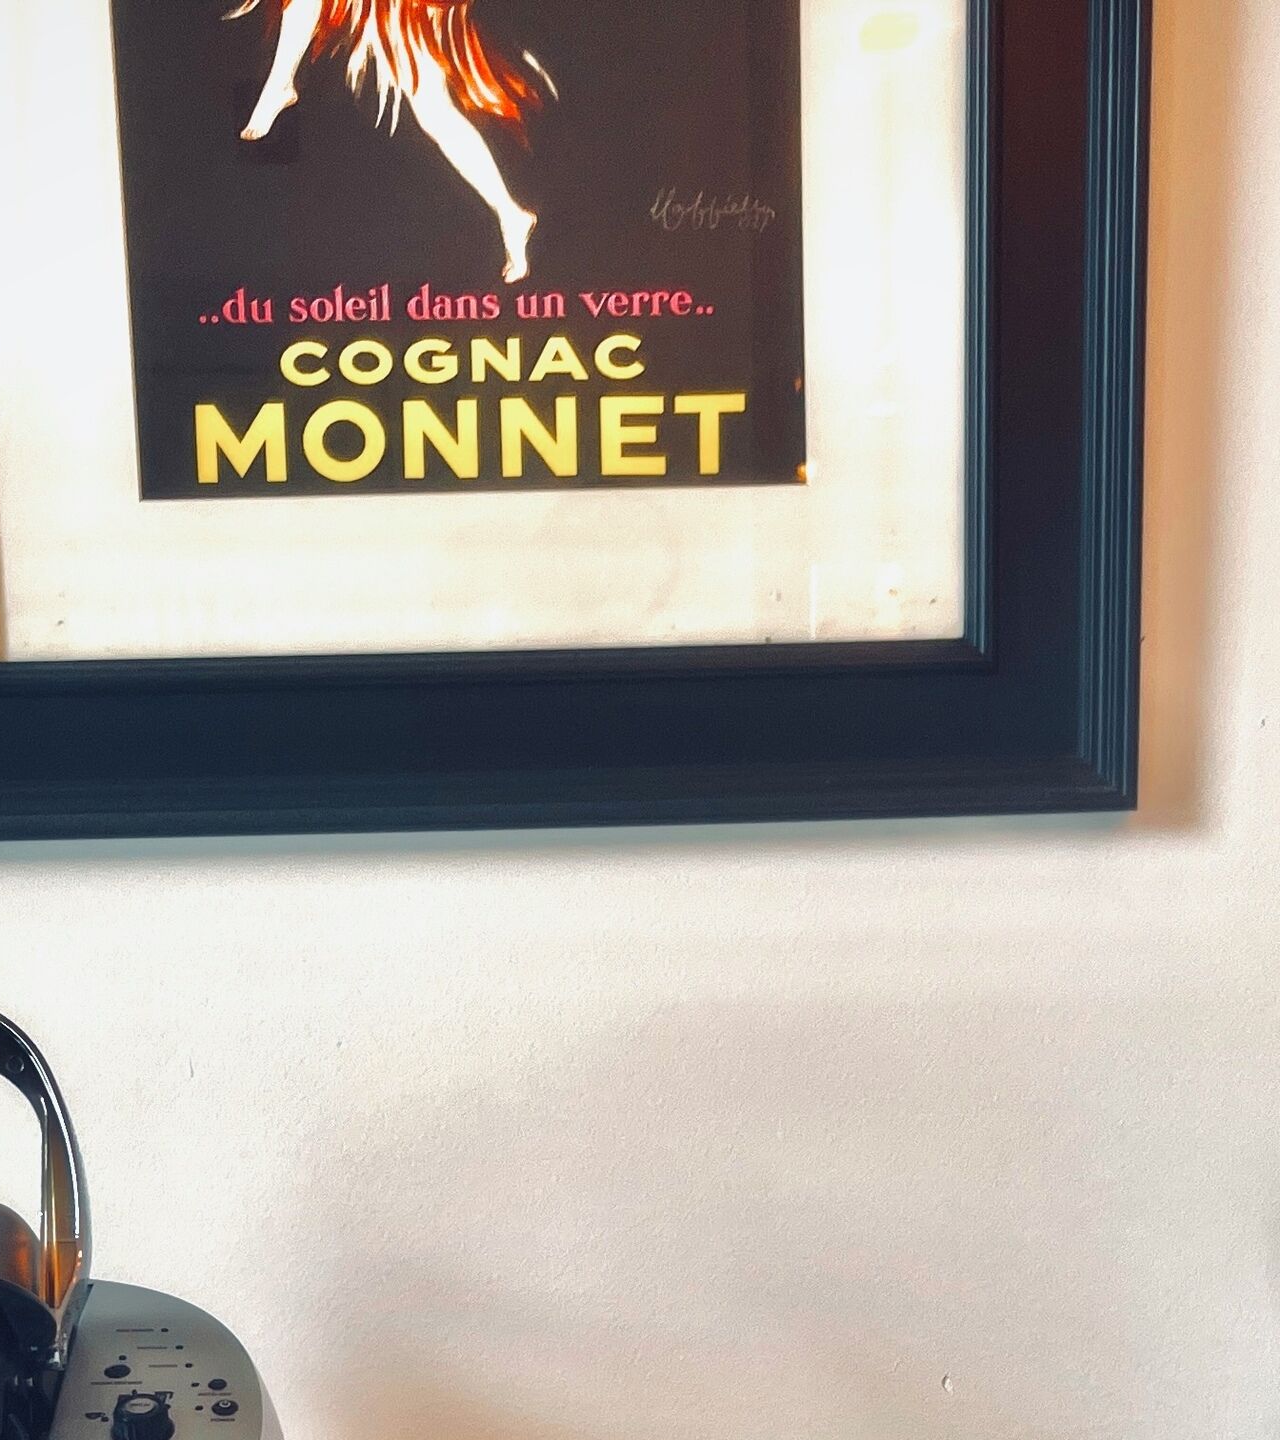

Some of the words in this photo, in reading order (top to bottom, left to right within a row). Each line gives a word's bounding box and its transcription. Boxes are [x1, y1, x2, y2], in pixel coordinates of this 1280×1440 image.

[288, 283, 391, 323] soleil
[406, 284, 499, 321] dans
[516, 292, 566, 319] un
[279, 334, 645, 387] COGNAC
[194, 393, 746, 484] MONNET
